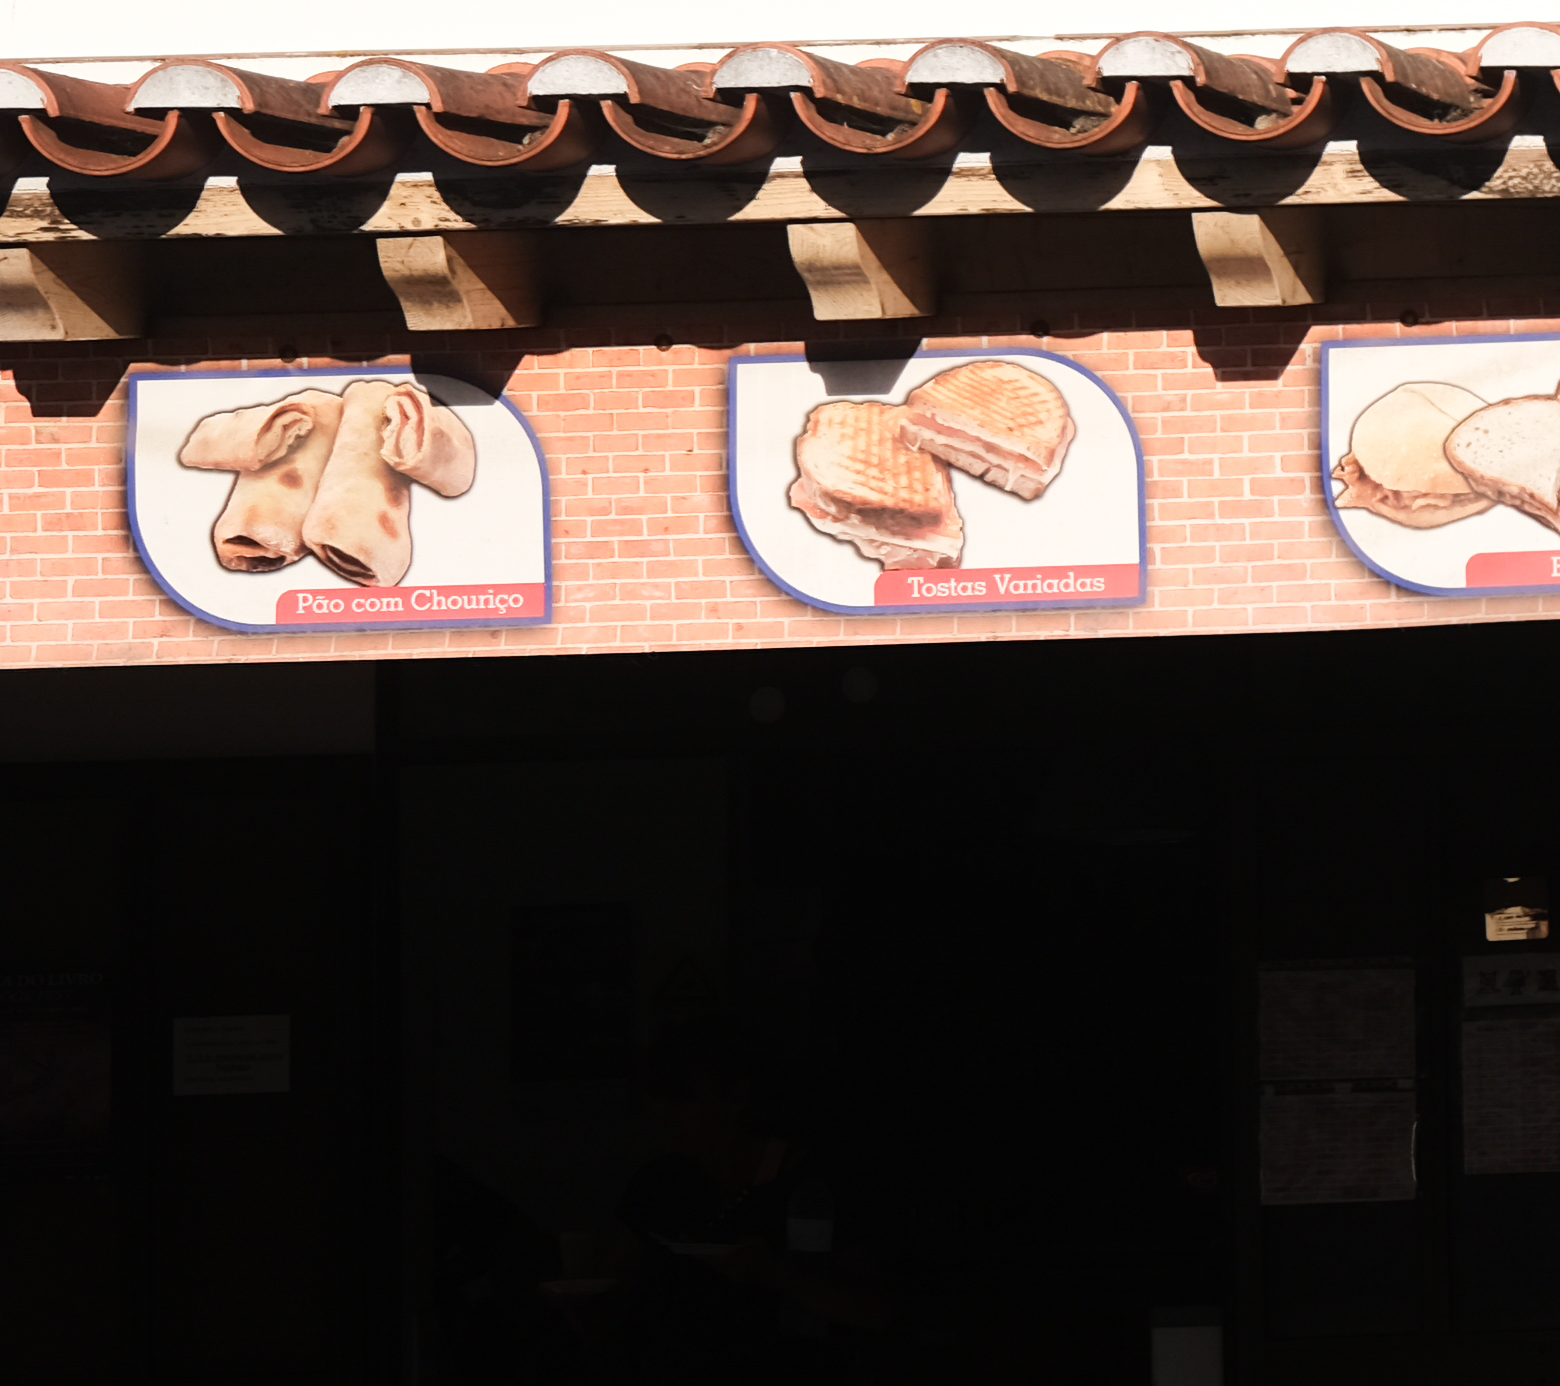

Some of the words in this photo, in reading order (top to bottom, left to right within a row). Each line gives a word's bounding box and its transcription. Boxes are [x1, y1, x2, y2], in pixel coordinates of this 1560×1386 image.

[907, 576, 987, 598] Tostas
[993, 571, 1105, 595] Variadas
[296, 592, 345, 614] Pão
[351, 596, 404, 613] com
[410, 589, 524, 614] Chouriço
